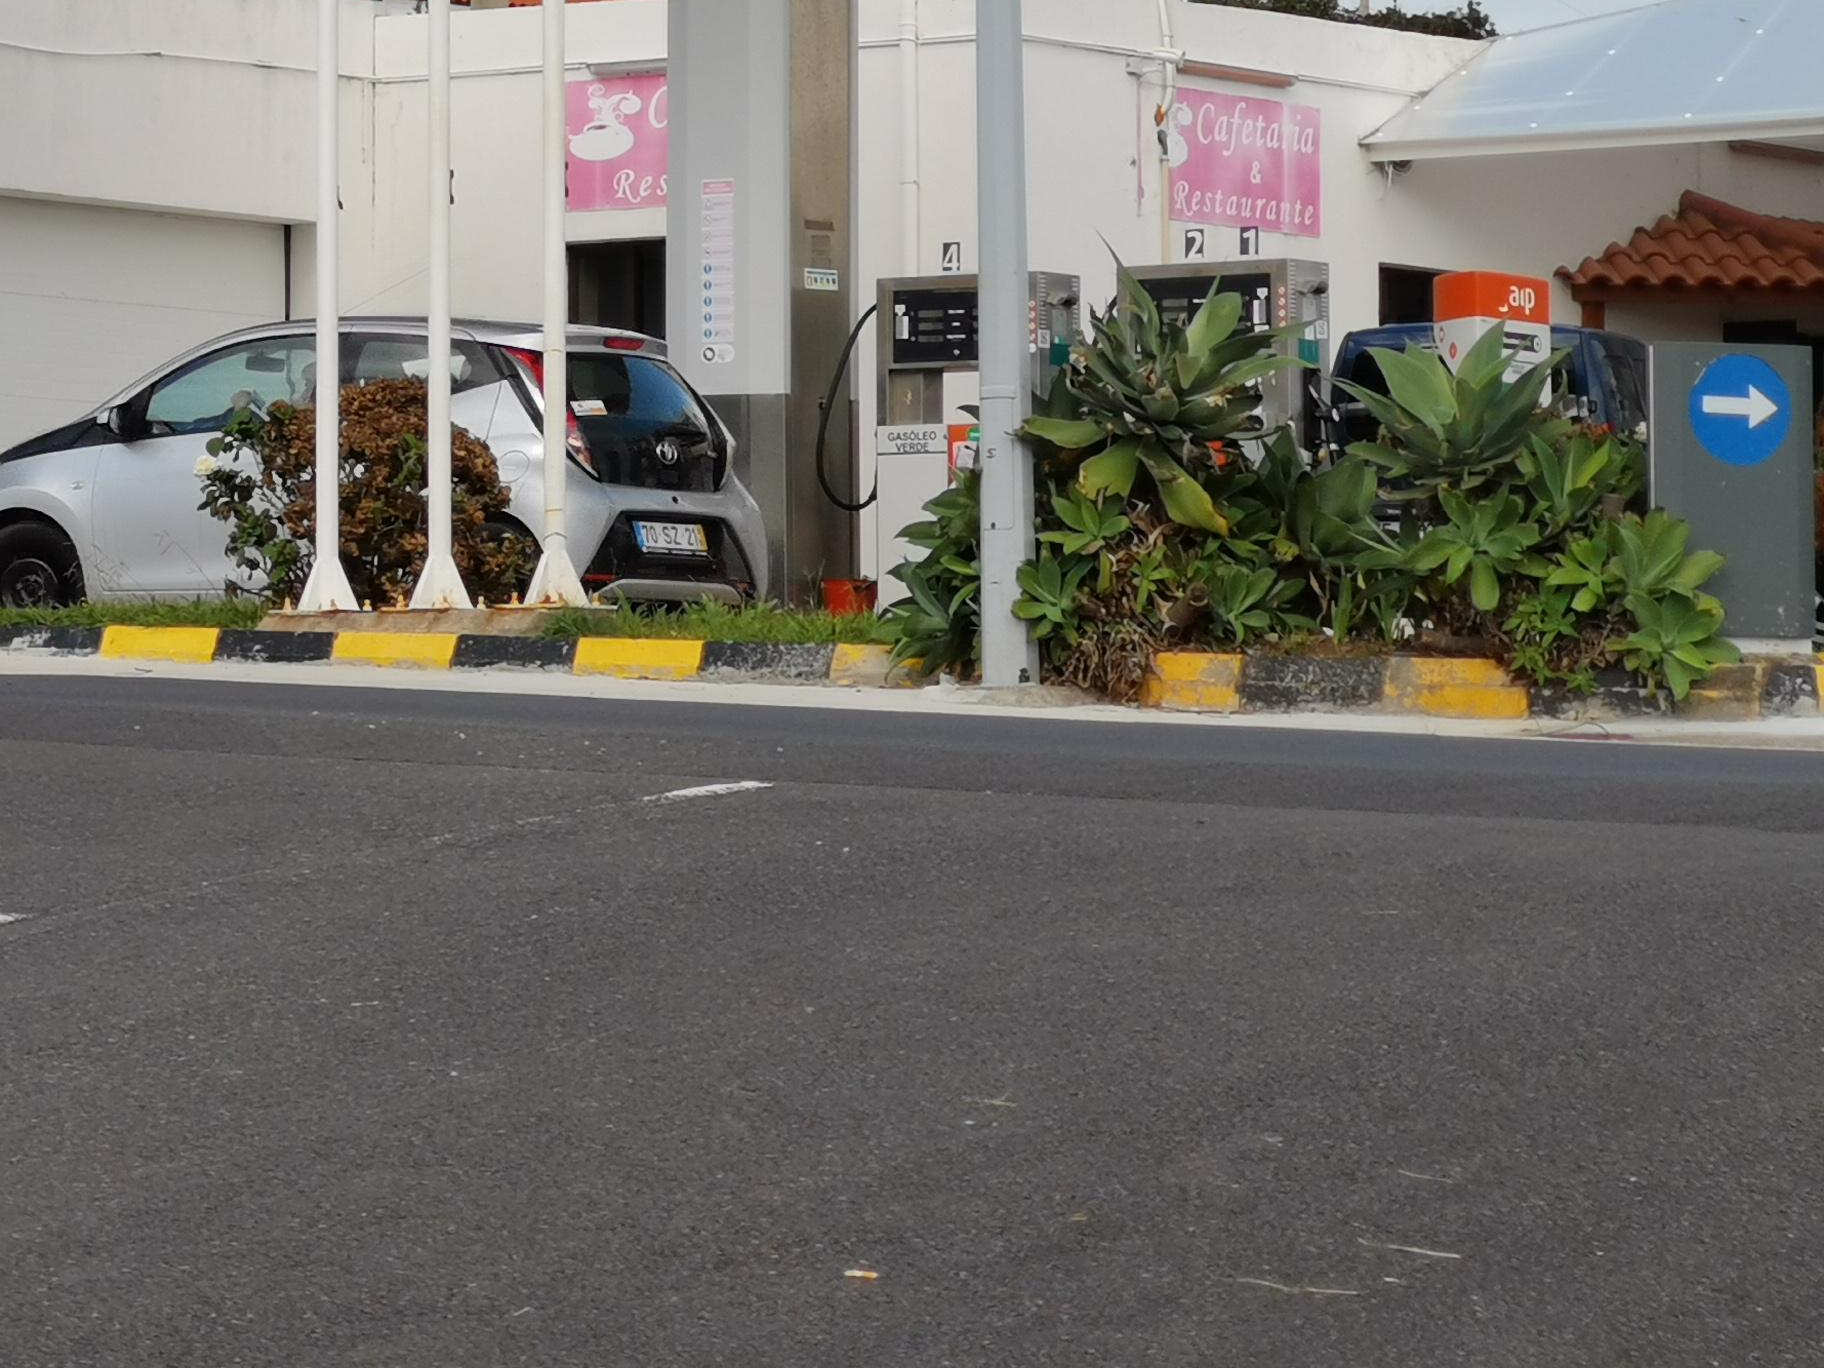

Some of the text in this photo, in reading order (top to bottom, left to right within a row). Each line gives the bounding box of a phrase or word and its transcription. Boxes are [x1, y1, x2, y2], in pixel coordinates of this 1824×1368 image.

[1250, 160, 1262, 184] &
[1174, 180, 1314, 226] Restaurante
[1186, 230, 1204, 258] 2
[1242, 229, 1256, 255] 1
[943, 243, 960, 271] 4
[887, 430, 937, 442] GASÓLEO
[895, 442, 929, 453] VERDE
